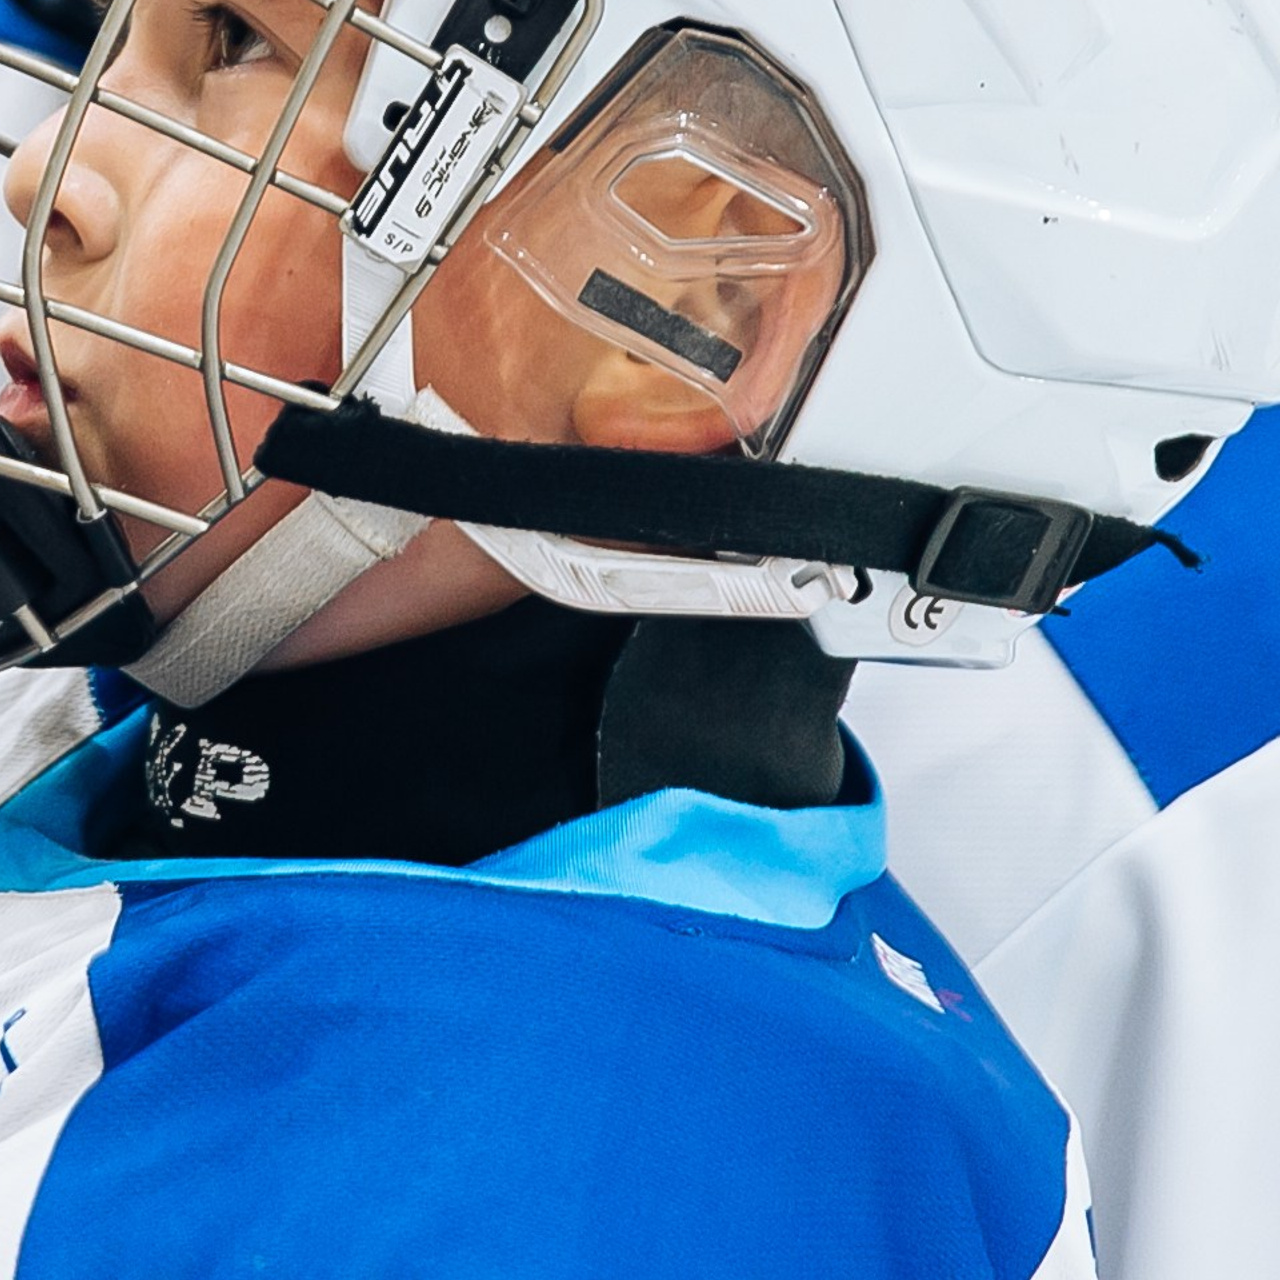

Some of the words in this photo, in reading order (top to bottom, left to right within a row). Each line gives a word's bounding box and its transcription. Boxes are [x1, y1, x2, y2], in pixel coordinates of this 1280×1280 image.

[355, 68, 463, 227] TRUE
[384, 232, 414, 255] S/P
[904, 593, 944, 630] CE
